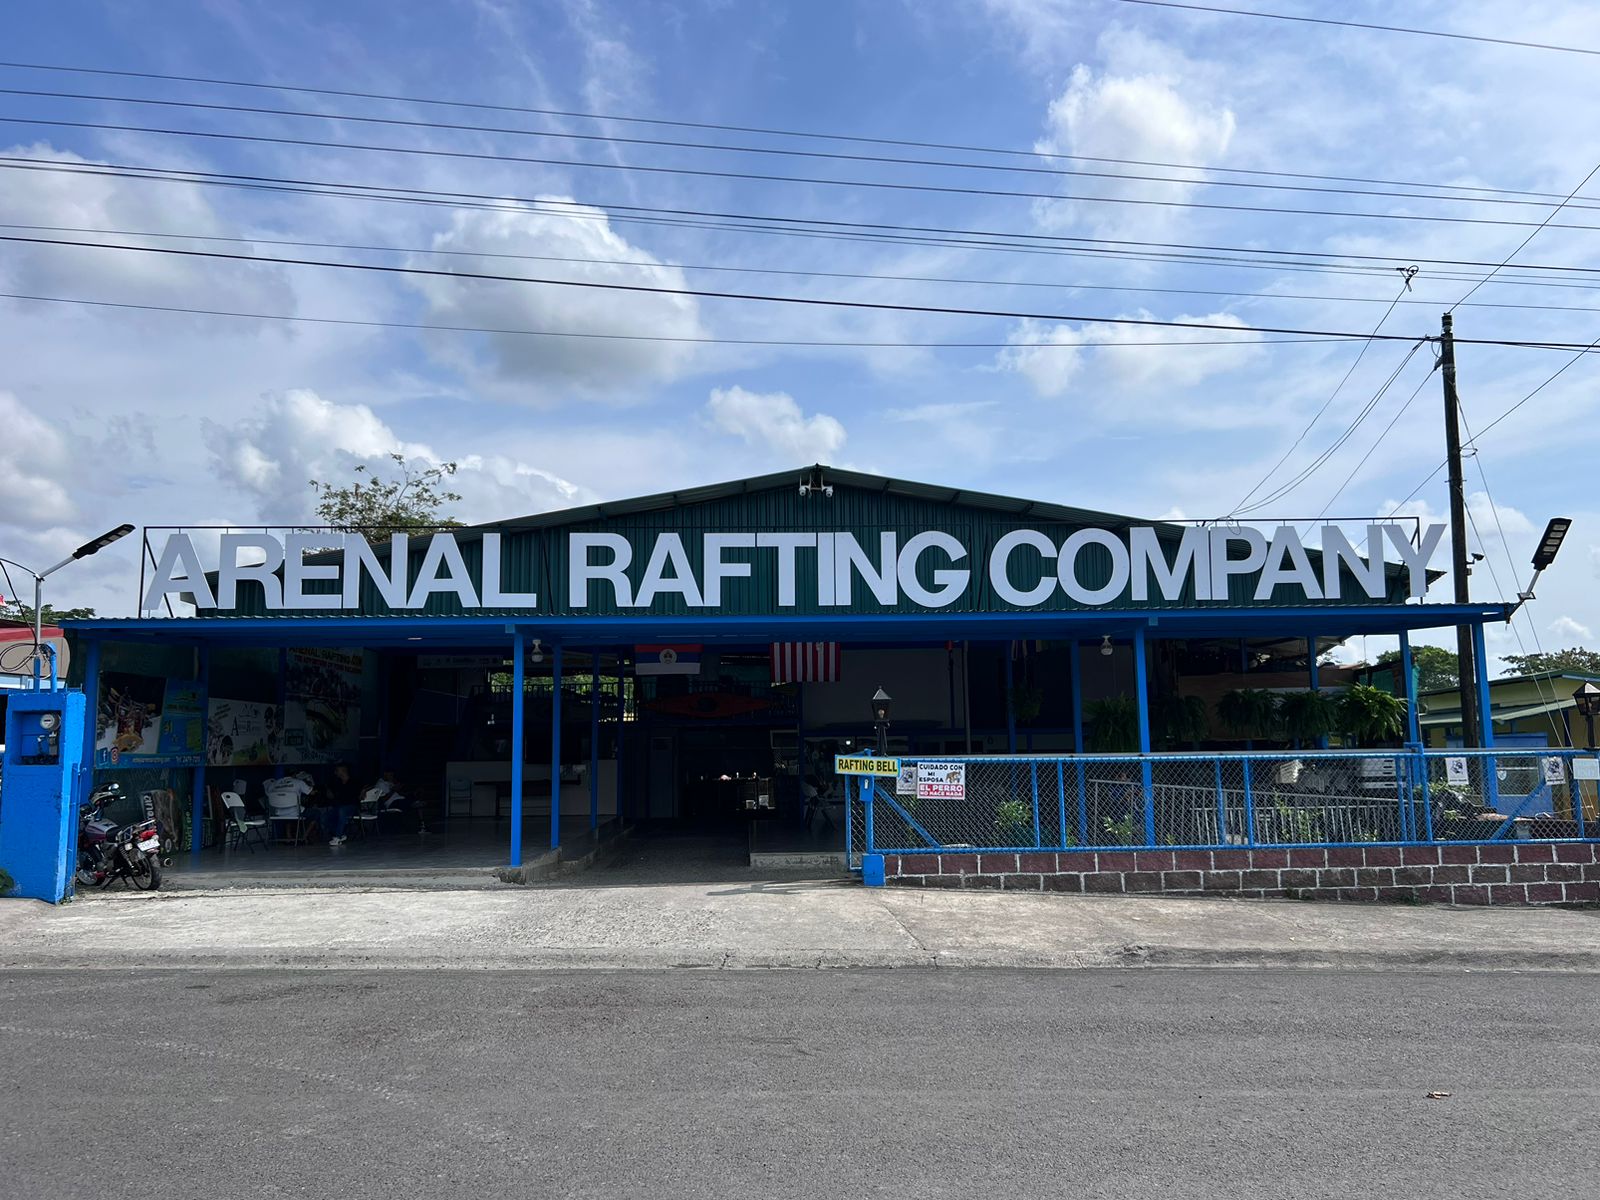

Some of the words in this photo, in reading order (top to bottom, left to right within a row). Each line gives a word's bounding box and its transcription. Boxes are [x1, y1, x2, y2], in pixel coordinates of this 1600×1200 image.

[142, 533, 537, 610] ARENAL
[568, 531, 971, 608] RAFTING
[989, 523, 1447, 607] COMPANY
[838, 758, 875, 771] RAFTING
[877, 760, 897, 772] BELL
[932, 784, 963, 792] PERRO
